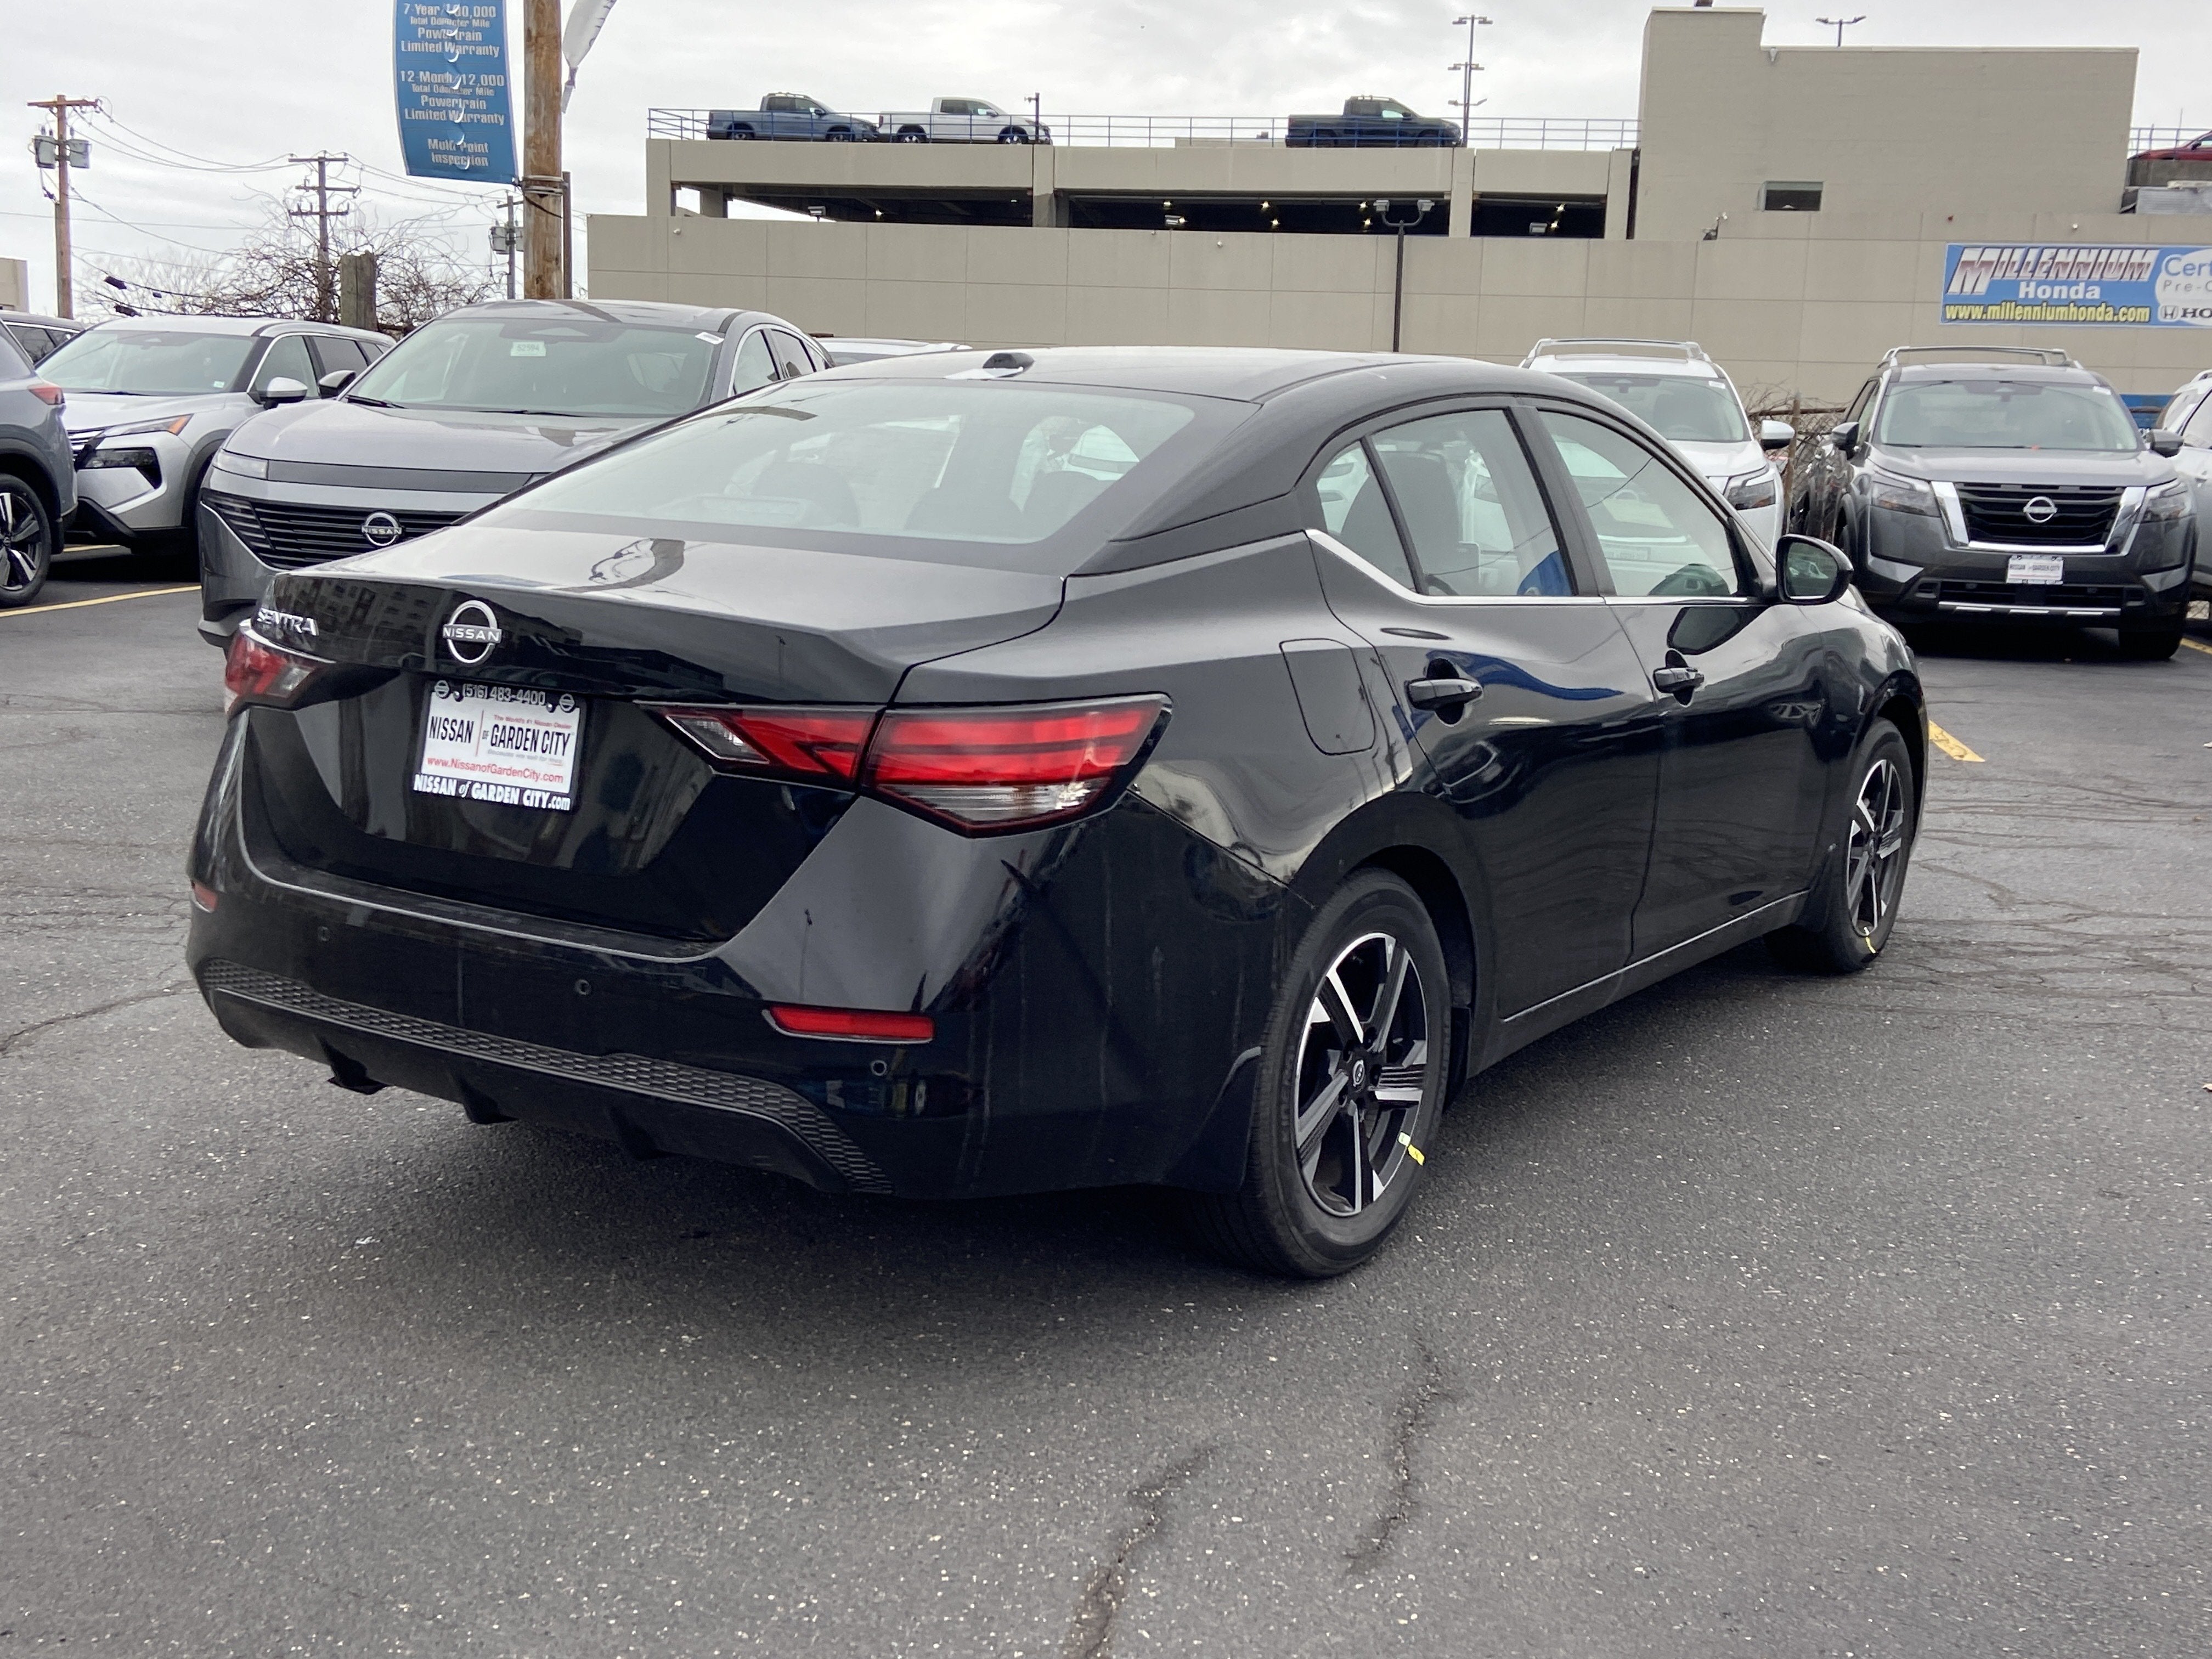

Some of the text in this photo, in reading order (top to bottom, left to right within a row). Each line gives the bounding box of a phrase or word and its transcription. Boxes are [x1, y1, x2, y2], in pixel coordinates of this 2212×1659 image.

[472, 19, 490, 28] Mile
[401, 40, 500, 58] Limited Warranty
[412, 83, 430, 93] Total
[476, 87, 495, 96] Mile
[421, 95, 487, 109] Powertrain
[405, 108, 446, 121] Limited
[431, 152, 489, 167] Inspection
[1946, 246, 2160, 295] MILLENNIUM
[2164, 256, 2212, 276] Cer
[2018, 281, 2101, 300] Honda
[1945, 300, 2151, 323] www.millenniumhonda.com
[257, 607, 319, 636] SENTRA
[443, 627, 499, 641] NISSAN
[462, 684, 546, 706] (516) 483-4400
[428, 715, 475, 743] NISSAN
[490, 724, 540, 753] GARDEN
[541, 730, 571, 756] CITY
[427, 756, 563, 784] www.NissanofGardenCity.com
[413, 774, 457, 795] NISSAN
[459, 781, 472, 798] of
[471, 782, 521, 804] GARDEN
